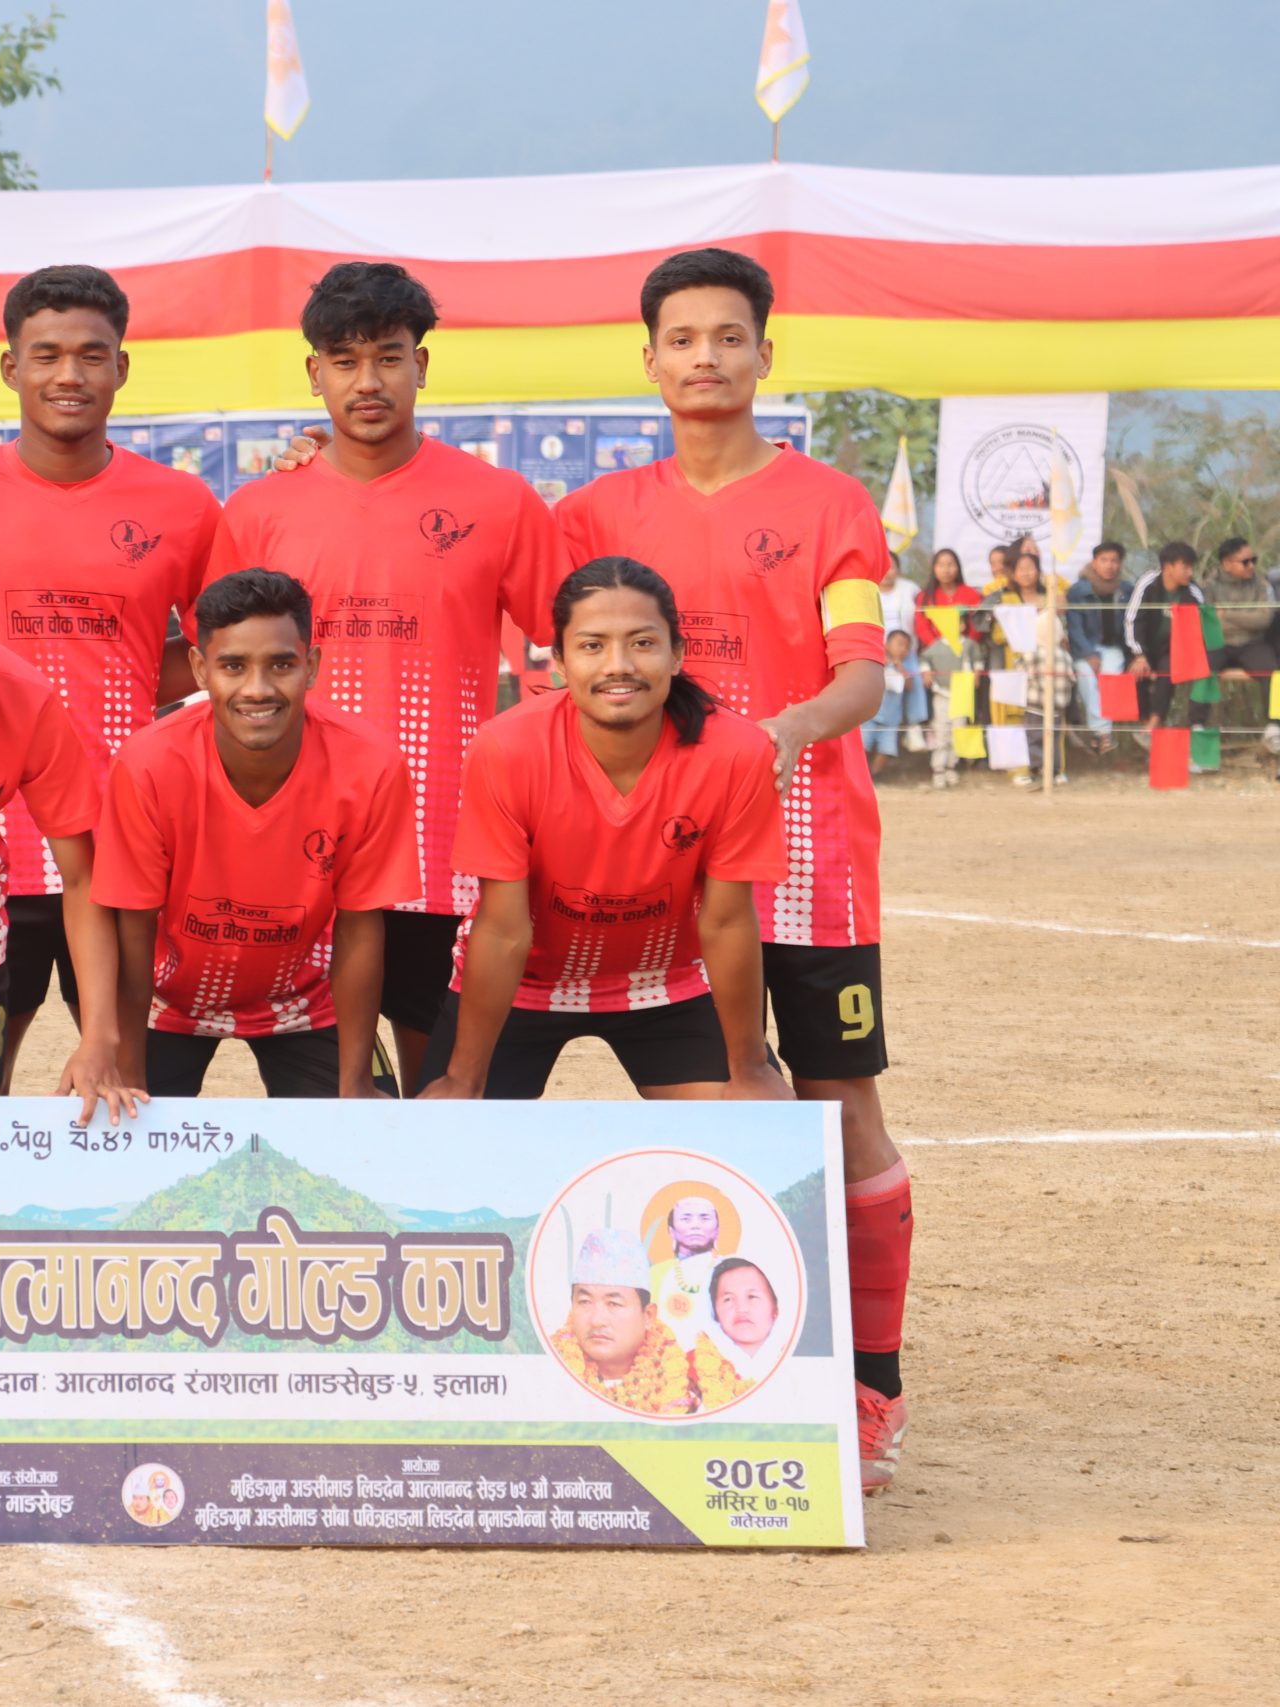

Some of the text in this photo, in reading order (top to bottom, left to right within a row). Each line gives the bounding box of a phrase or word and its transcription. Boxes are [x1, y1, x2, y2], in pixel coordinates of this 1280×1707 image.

[11, 610, 44, 635] पिपल
[48, 611, 73, 635] चोक
[346, 614, 372, 638] चोक
[838, 984, 875, 1041] 9
[236, 1212, 386, 1335] गोल्ड
[401, 1242, 505, 1333] कप
[55, 1372, 177, 1395] आत्मानन्द
[184, 1368, 278, 1395] रंगशाला
[433, 1373, 507, 1397] इलाम)
[706, 1459, 806, 1490] २०८२
[408, 1479, 474, 1499] आत्मानन्द
[510, 1481, 527, 1499] ७२
[552, 1476, 612, 1500] जन्मोत्सव
[705, 1490, 759, 1512] मंसिर
[550, 1506, 574, 1530] सेवा
[578, 1506, 650, 1530] महासमारोह
